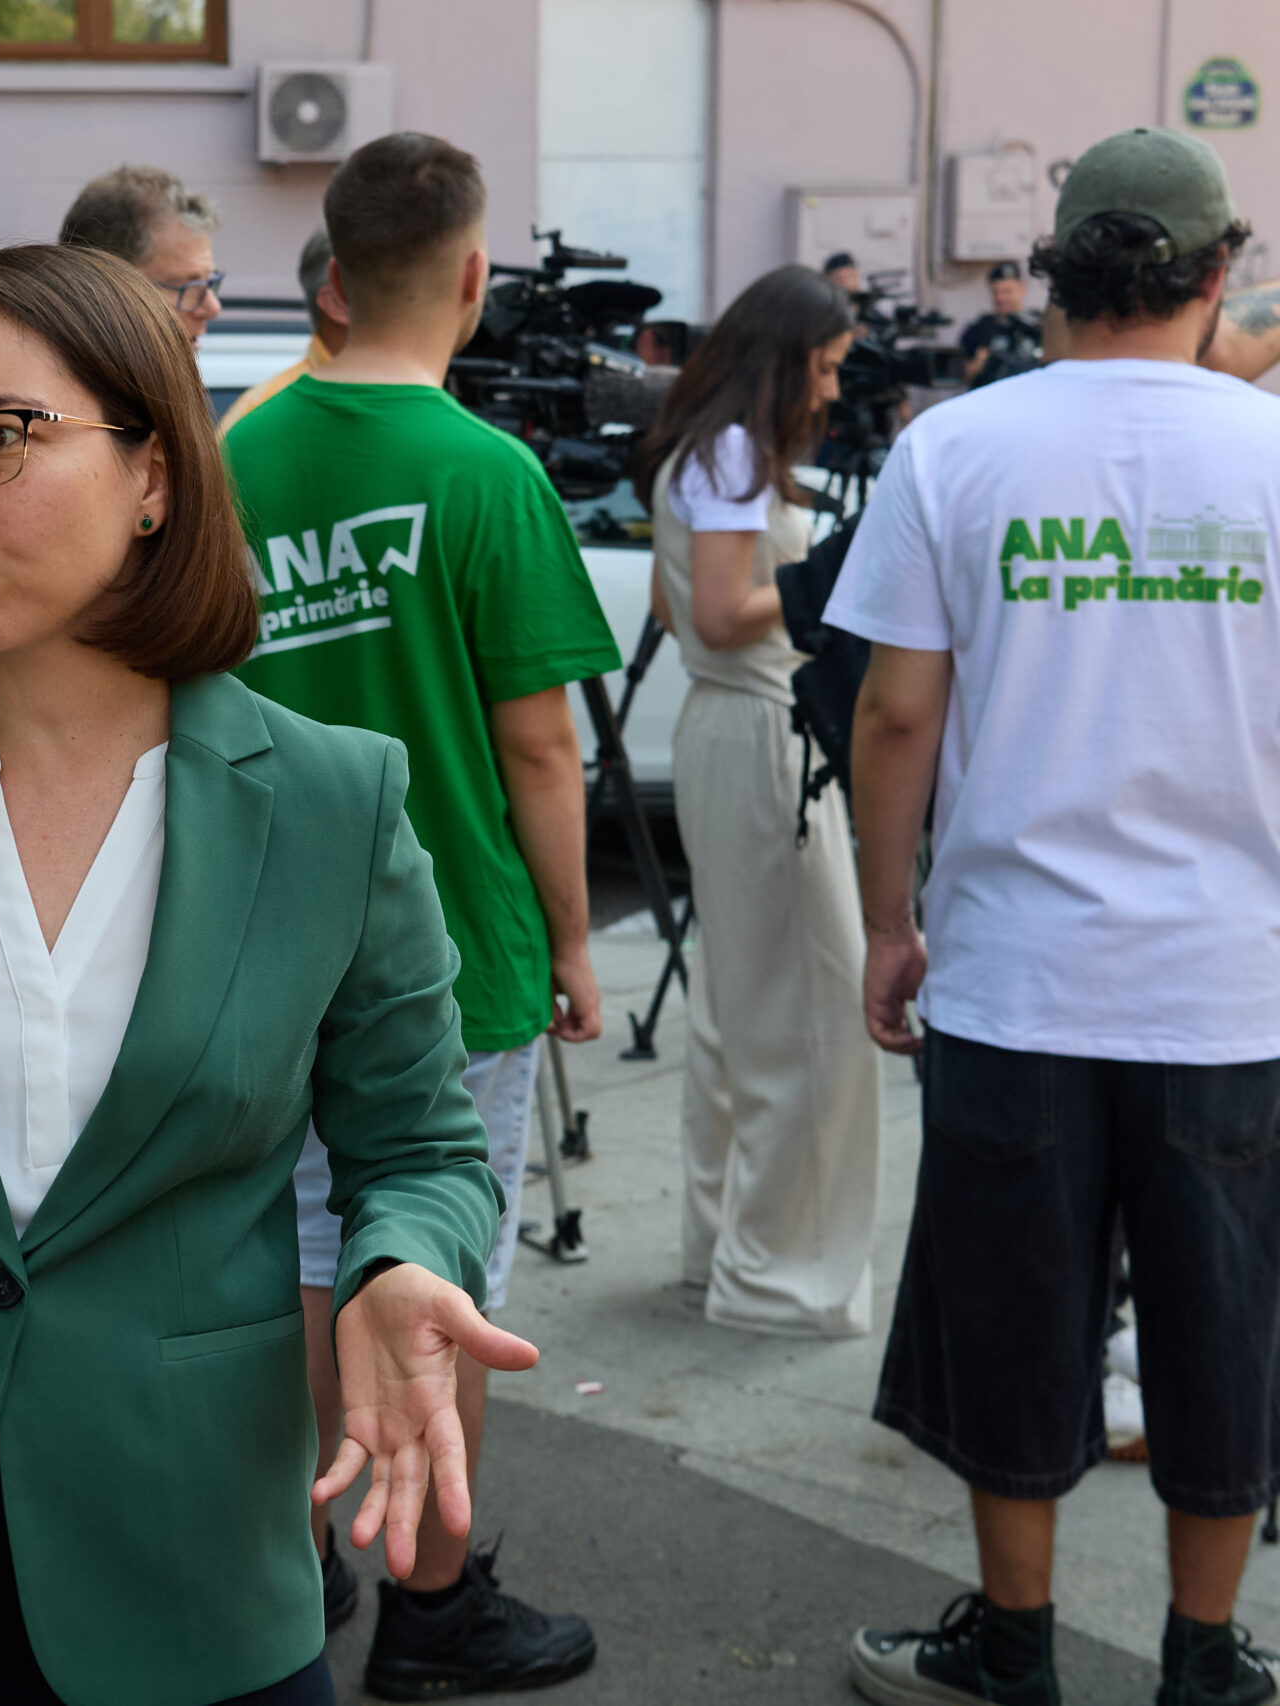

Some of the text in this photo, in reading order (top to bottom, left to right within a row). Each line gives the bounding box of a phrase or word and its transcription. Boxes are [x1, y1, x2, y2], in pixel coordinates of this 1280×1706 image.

[1000, 518, 1132, 561] ANA
[260, 578, 389, 641] primărie
[1000, 563, 1264, 611] La primărie
